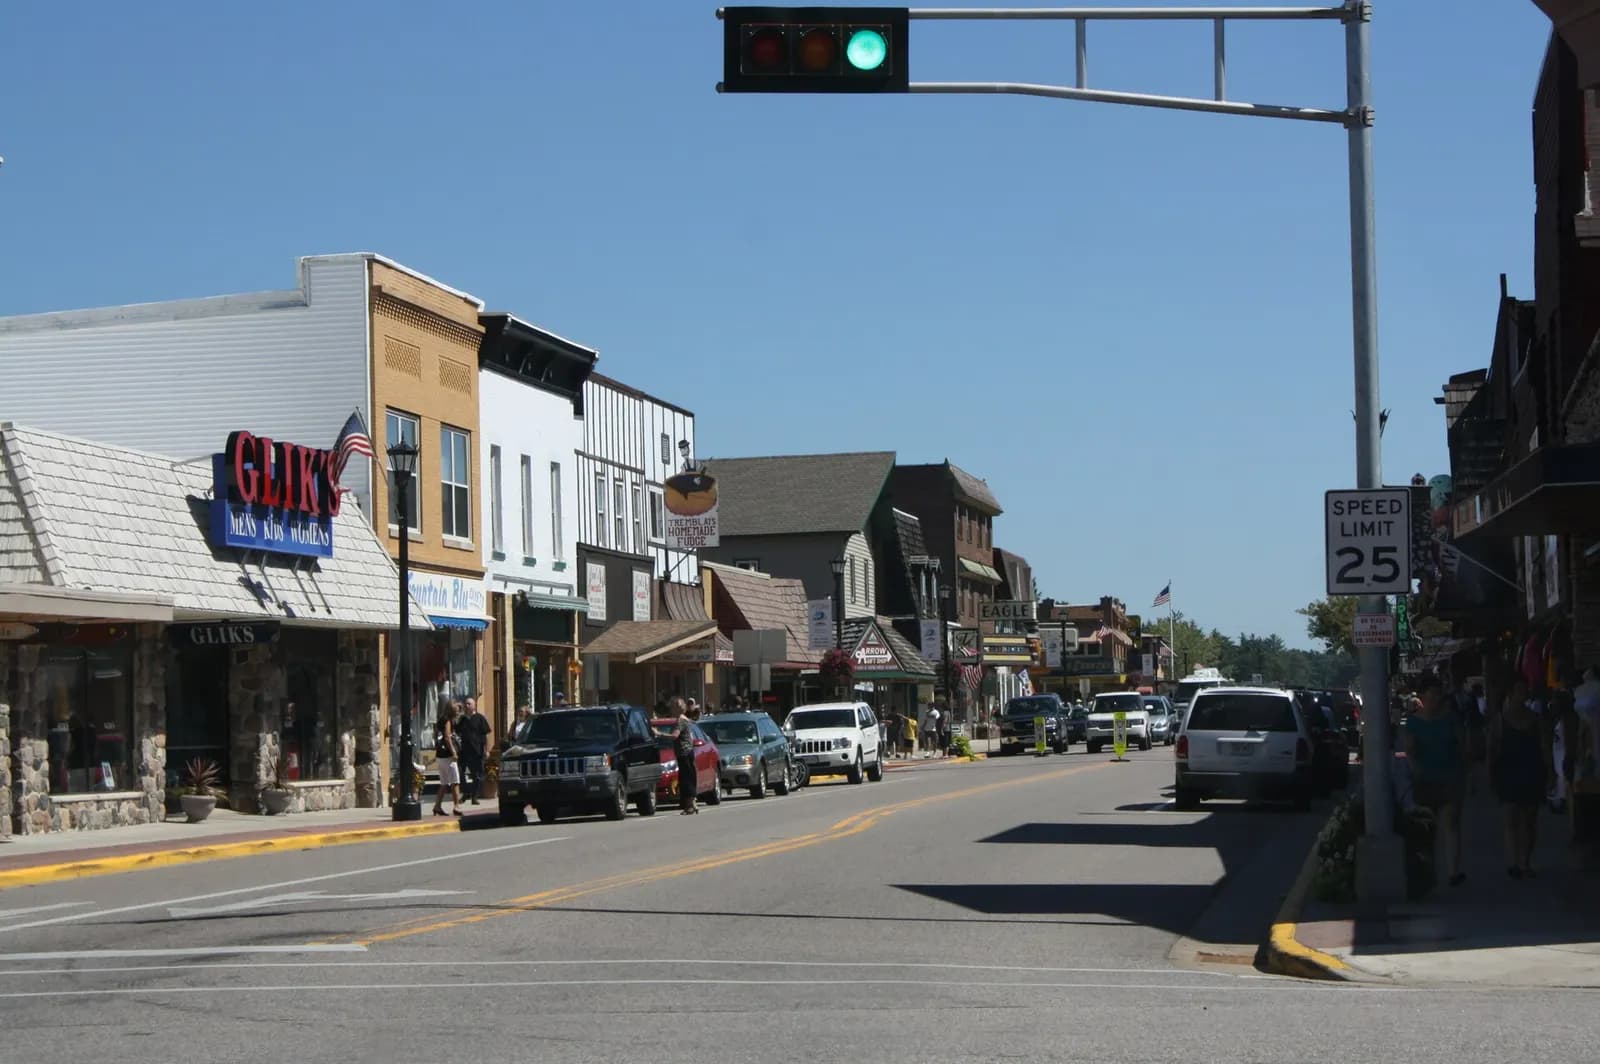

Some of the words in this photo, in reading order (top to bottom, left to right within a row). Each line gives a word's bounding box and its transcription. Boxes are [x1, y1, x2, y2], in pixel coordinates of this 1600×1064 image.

[1333, 499, 1402, 516] SPEED
[668, 526, 717, 537] HOMEMADE
[1341, 520, 1395, 537] LIMIT
[677, 536, 706, 547] FUDGE
[1335, 546, 1400, 584] 25
[982, 604, 1029, 618] EAGLE
